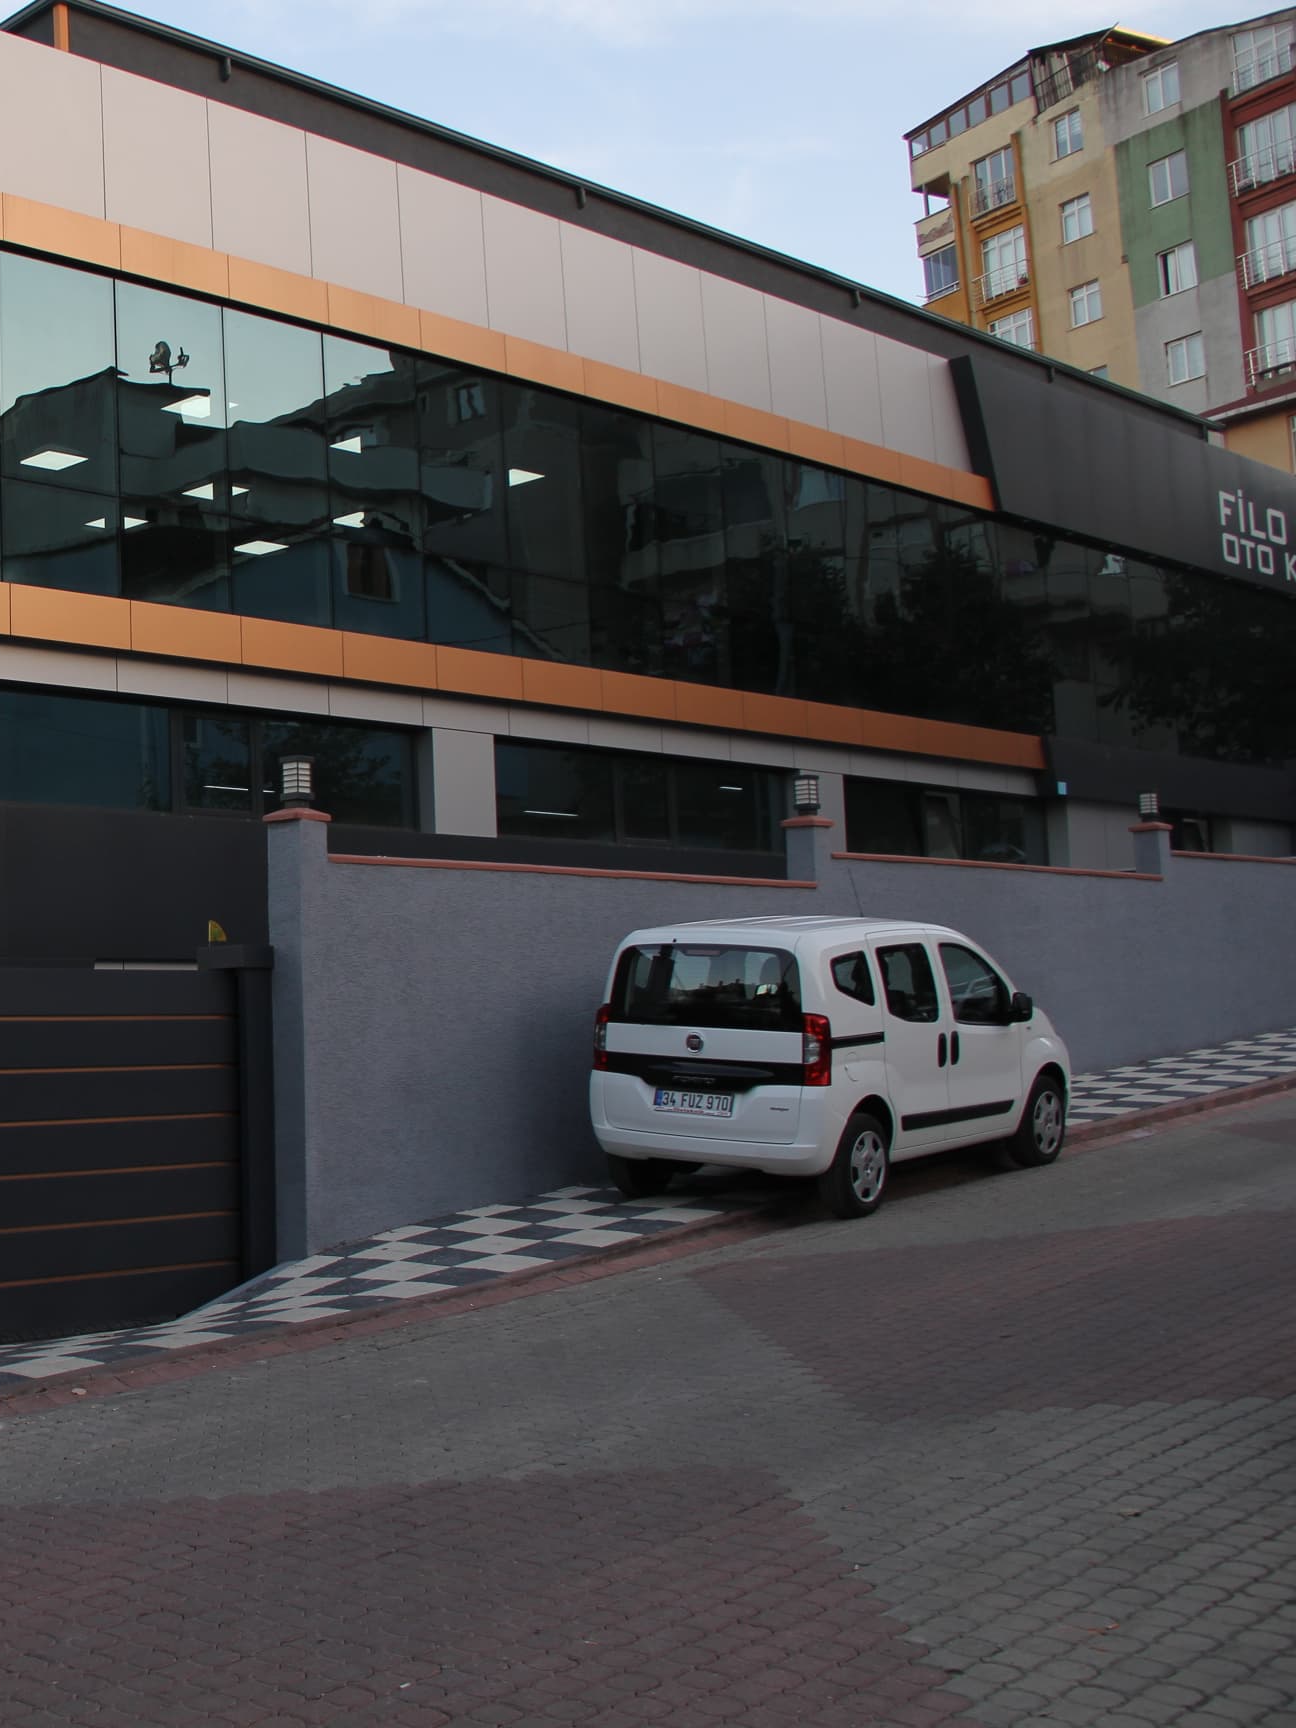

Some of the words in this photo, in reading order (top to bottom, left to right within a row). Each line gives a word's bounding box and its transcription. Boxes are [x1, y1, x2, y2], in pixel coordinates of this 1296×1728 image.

[1218, 489, 1287, 545] FİLO
[1222, 533, 1274, 575] OTO
[663, 1092, 675, 1106] 34
[680, 1093, 703, 1109] FUZ
[706, 1096, 729, 1111] 970
